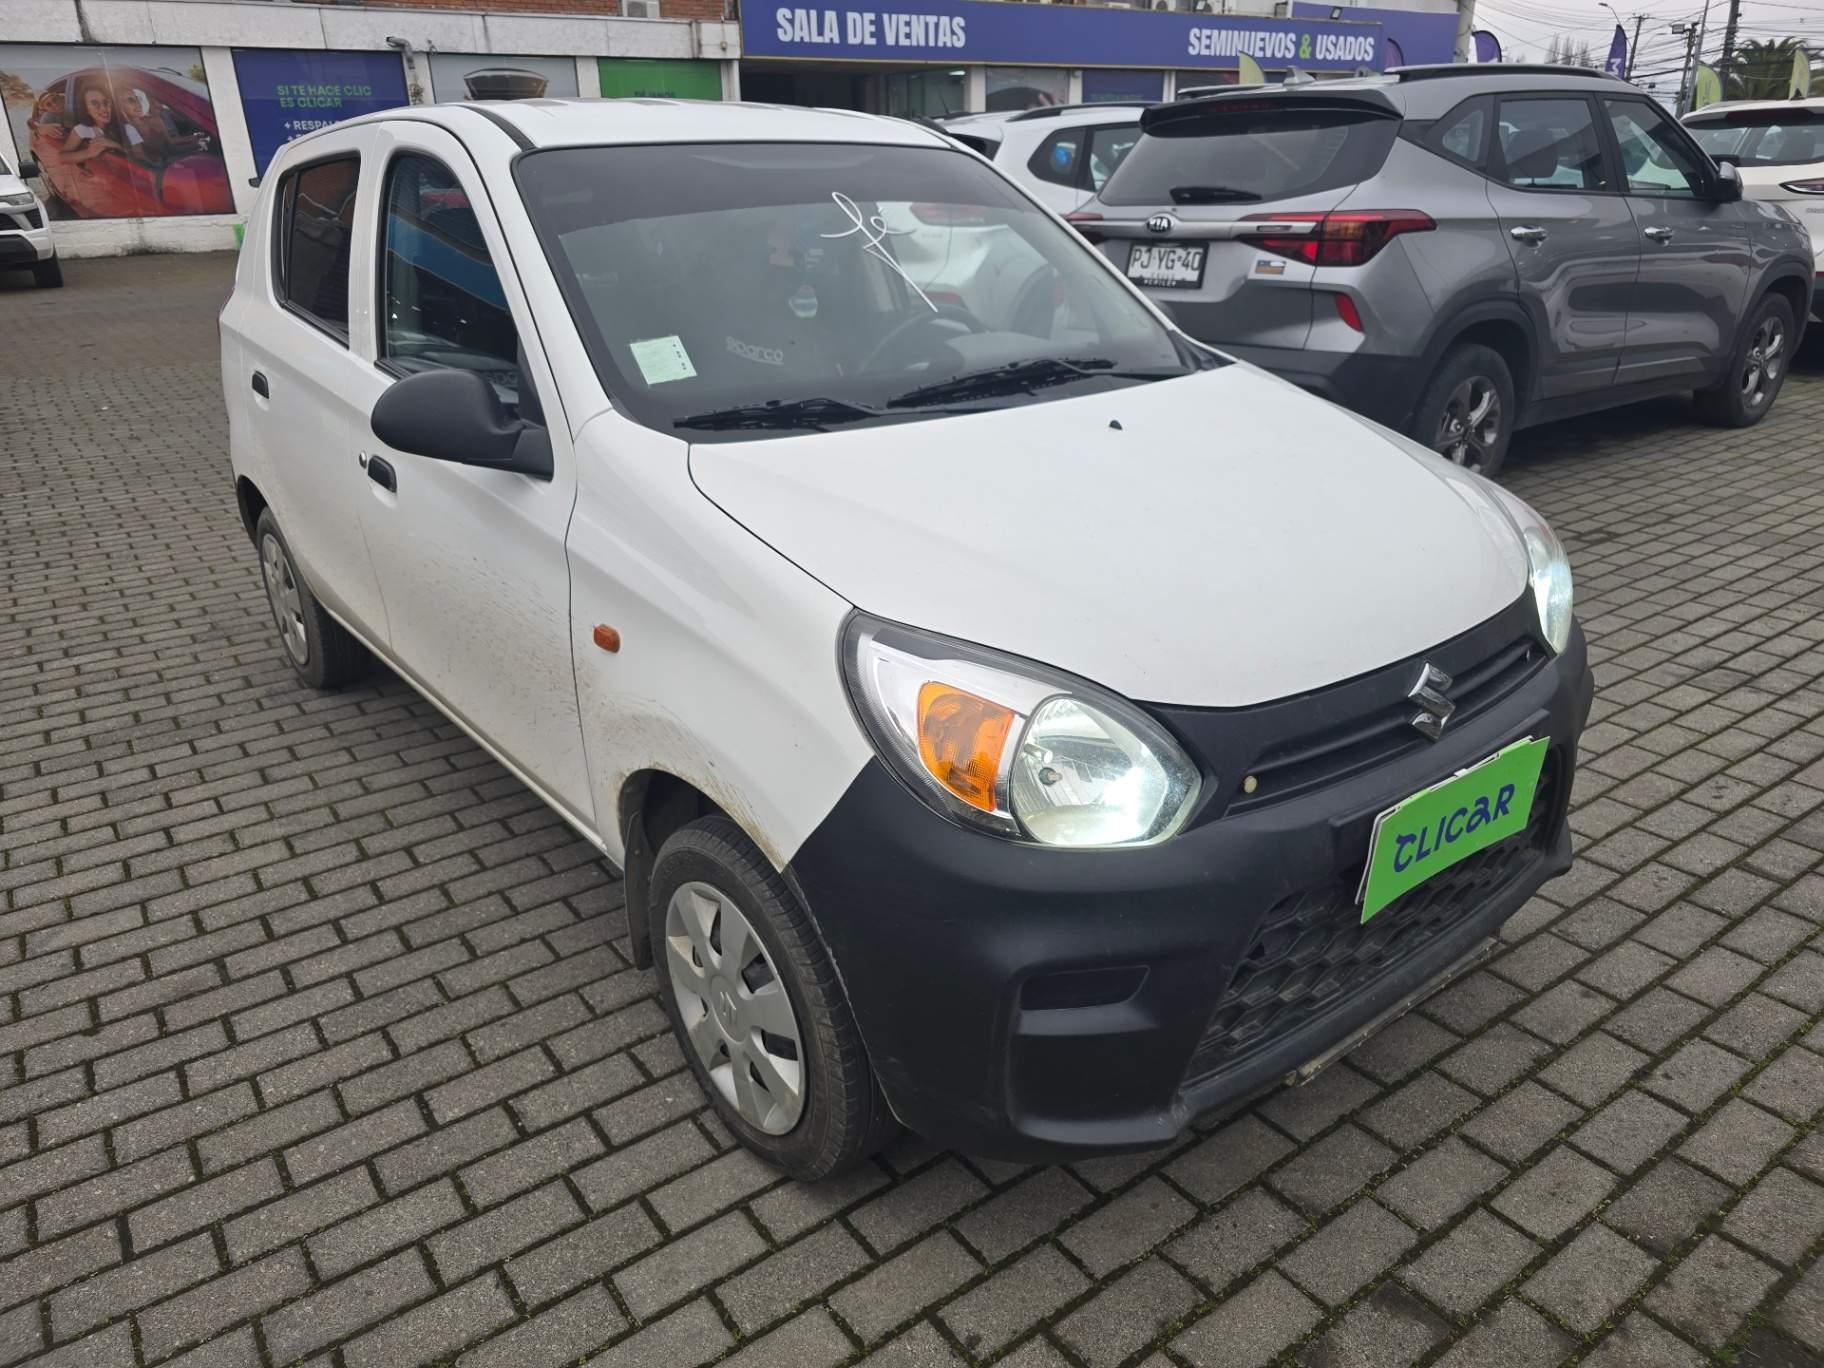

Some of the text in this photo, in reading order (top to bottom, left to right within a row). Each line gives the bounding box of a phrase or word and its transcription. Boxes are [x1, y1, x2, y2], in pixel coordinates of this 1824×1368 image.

[776, 7, 967, 48] SALA DE VENTAS
[1188, 27, 1375, 62] SEMINUEVOS & USADOS
[277, 85, 372, 96] SI TE HACE CLIC
[280, 97, 295, 108] ES
[293, 120, 341, 131] RESPA
[1149, 218, 1169, 230] KIA
